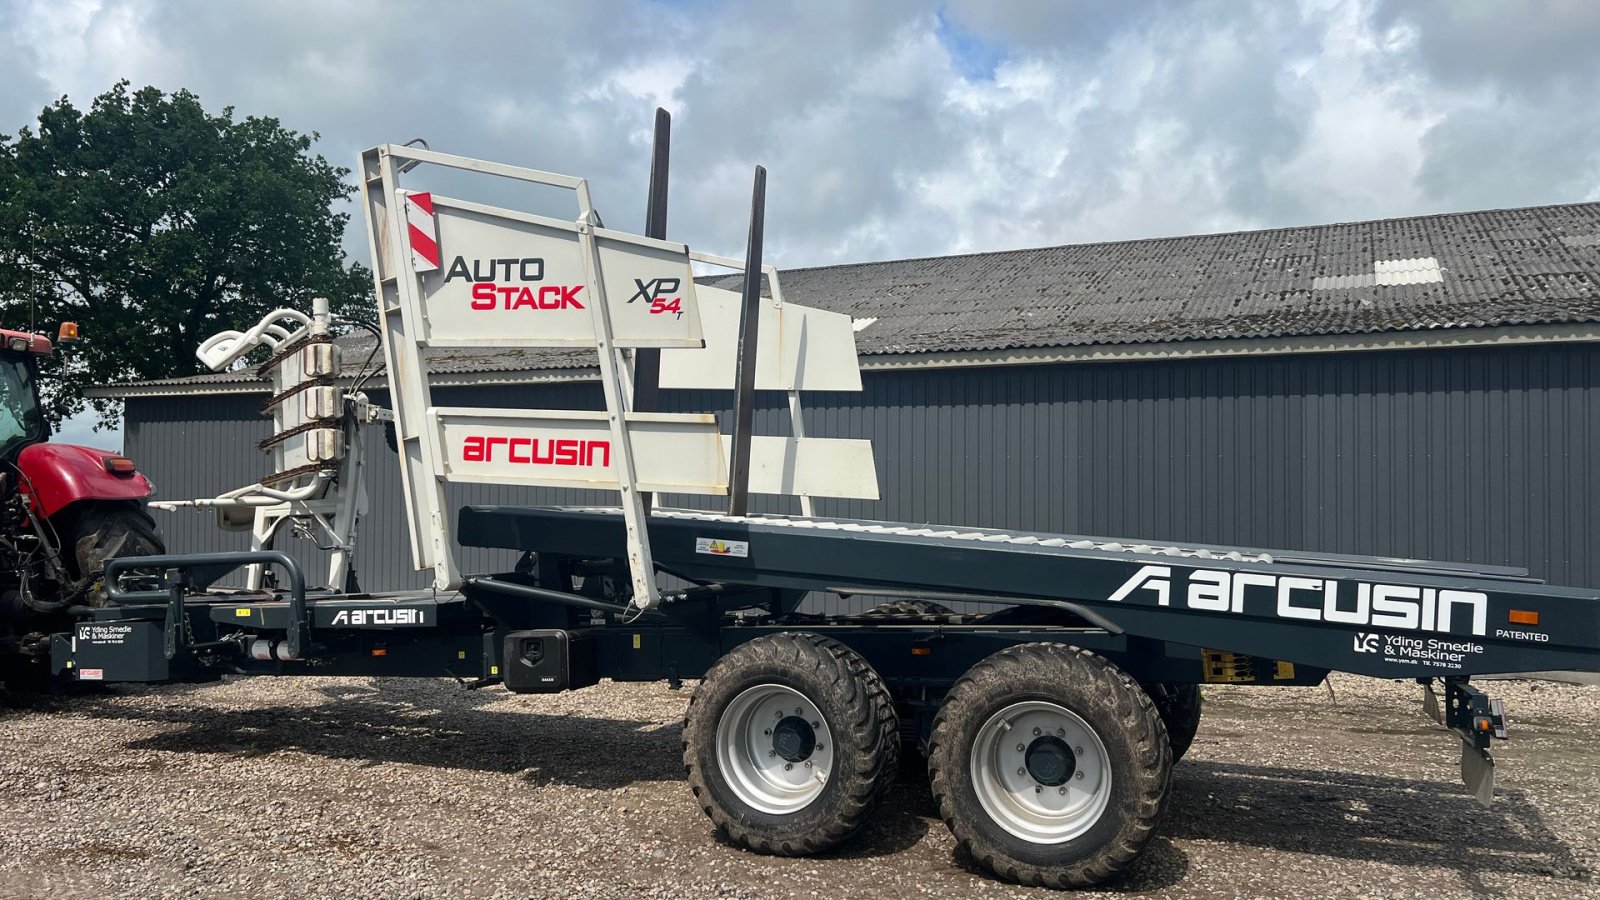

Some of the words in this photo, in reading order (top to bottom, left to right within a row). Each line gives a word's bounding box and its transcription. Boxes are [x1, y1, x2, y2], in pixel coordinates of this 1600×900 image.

[444, 255, 545, 283] AUTO
[470, 283, 586, 311] STACK
[626, 278, 681, 304] XP
[649, 297, 681, 314] 54
[676, 311, 684, 321] T
[462, 436, 610, 467] arcusin
[1187, 569, 1488, 636] arcusin
[351, 608, 424, 625] arcusin
[91, 626, 108, 634] Yding
[108, 625, 132, 633] Smedie
[91, 632, 98, 640] &
[1495, 629, 1549, 642] PATENTED
[1384, 634, 1423, 650] Yding
[1427, 638, 1484, 654] Smedie
[1384, 645, 1396, 655] &
[1399, 646, 1466, 661] Maskiner
